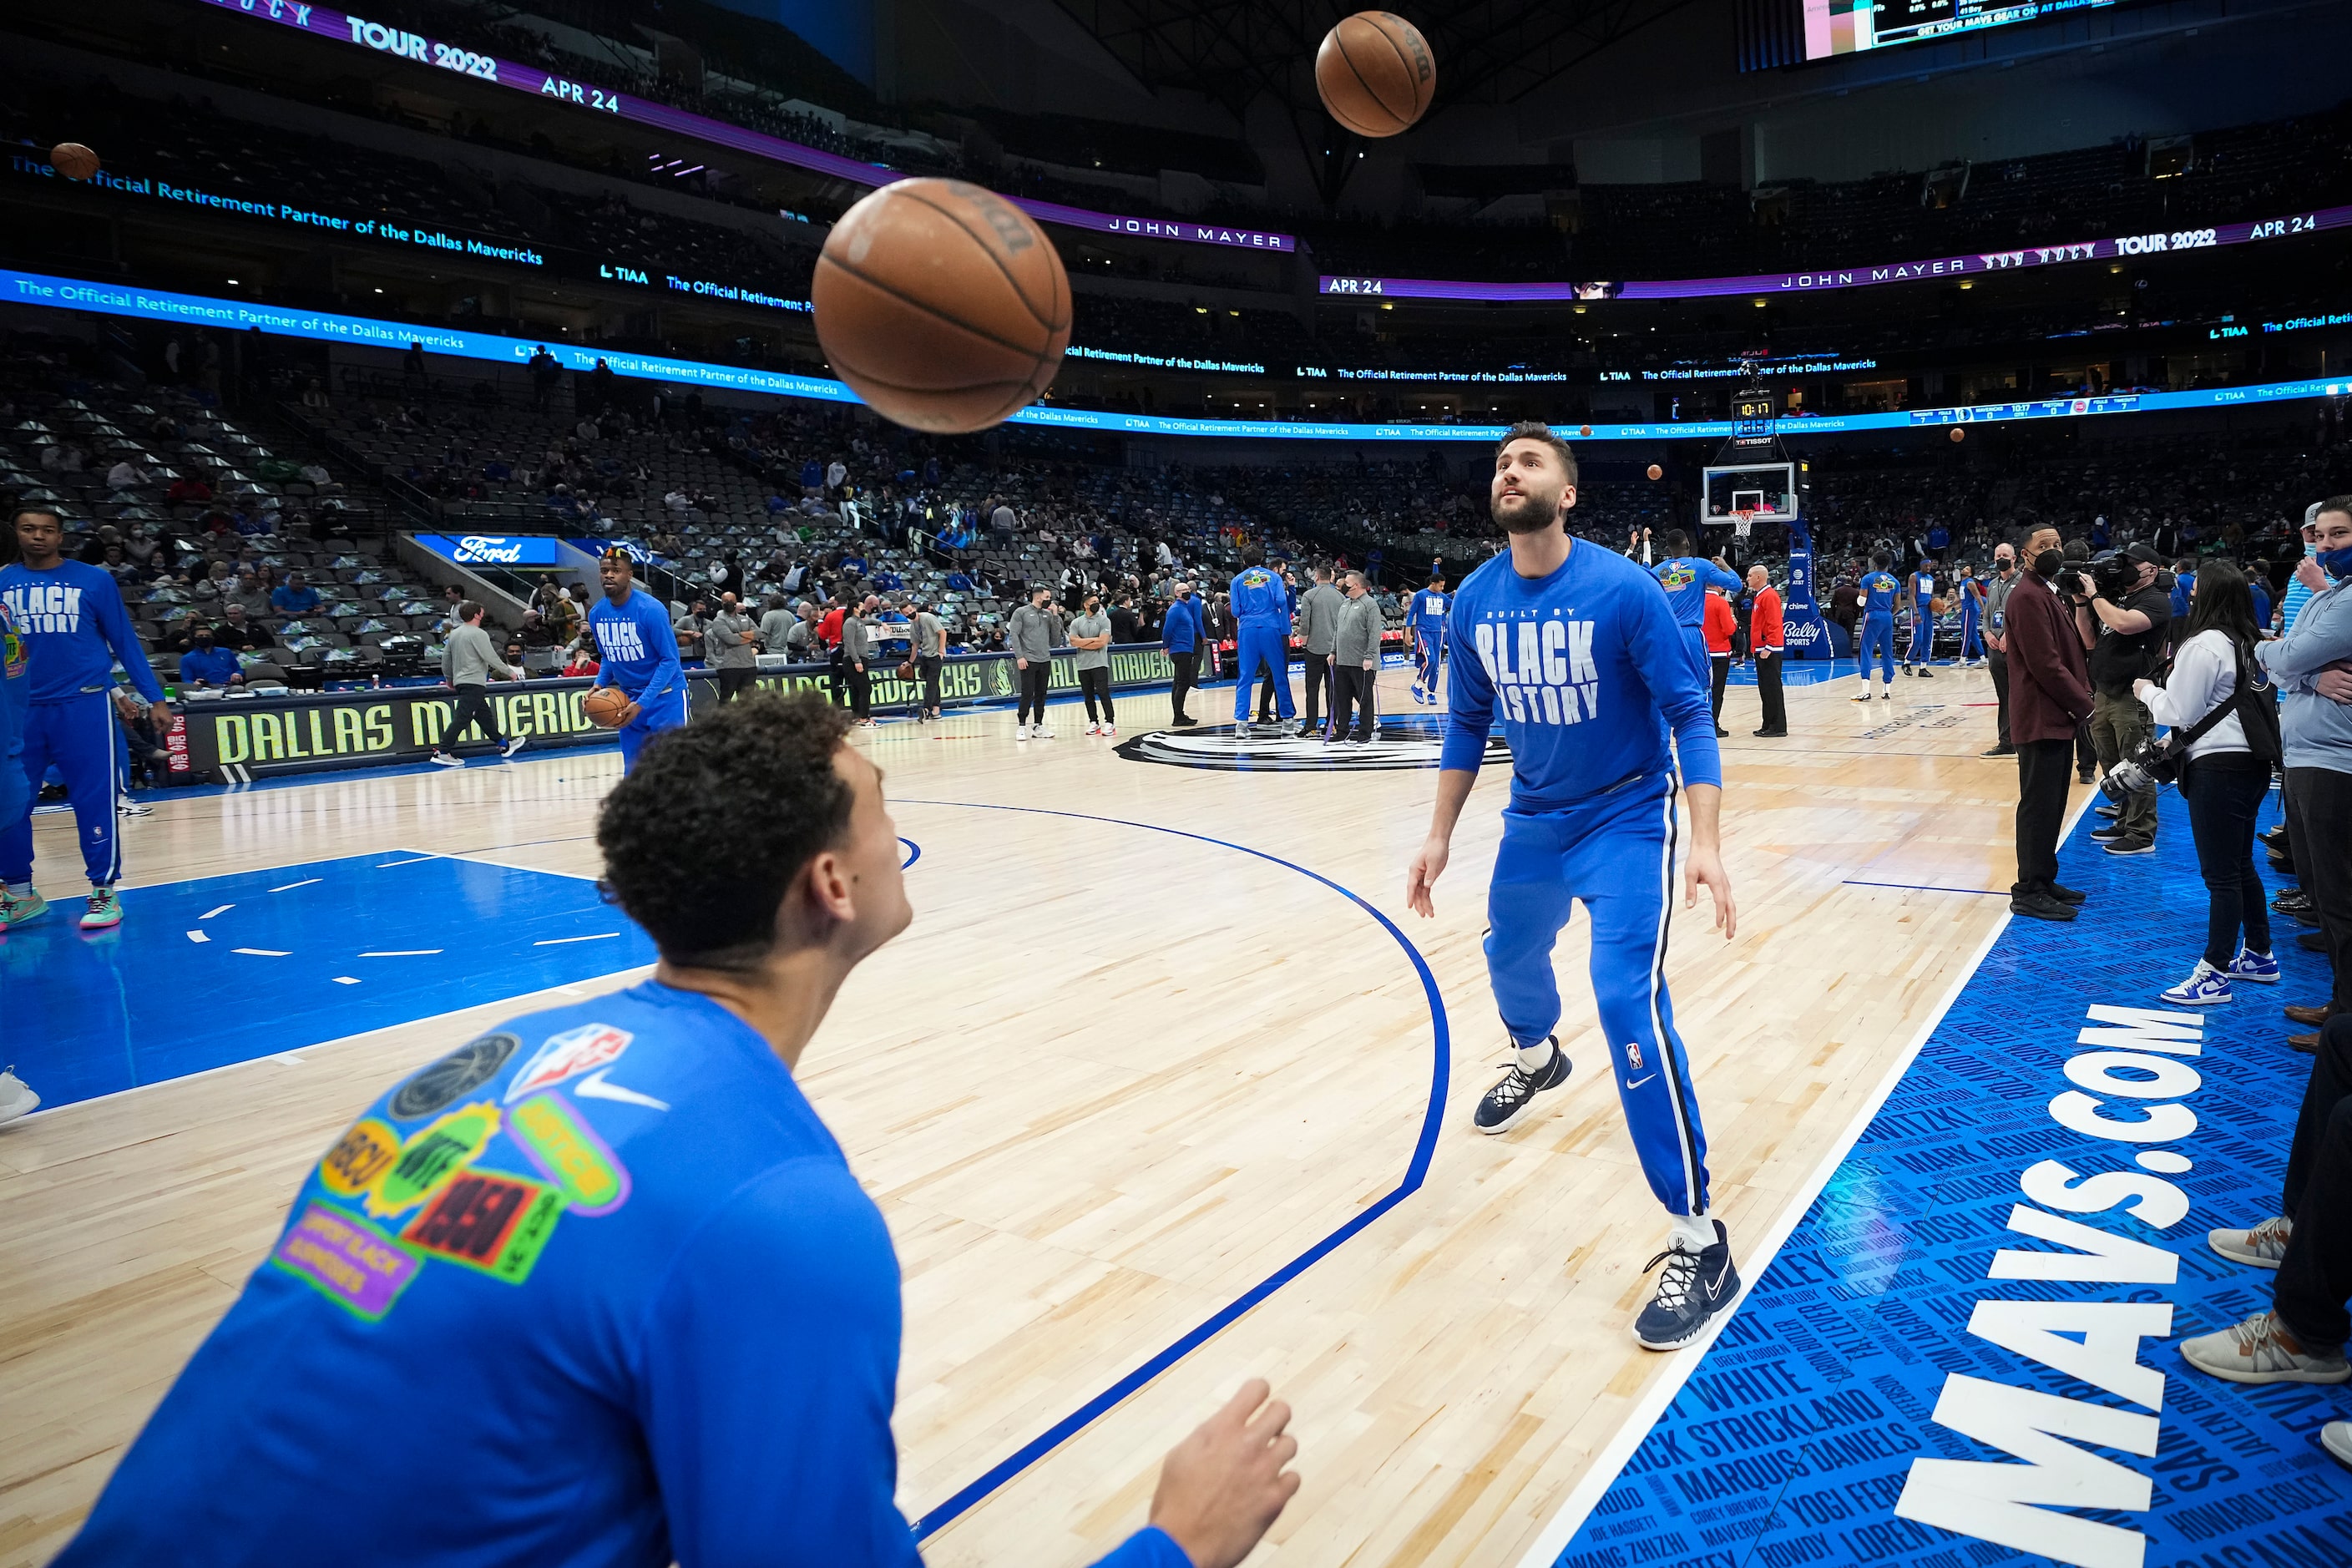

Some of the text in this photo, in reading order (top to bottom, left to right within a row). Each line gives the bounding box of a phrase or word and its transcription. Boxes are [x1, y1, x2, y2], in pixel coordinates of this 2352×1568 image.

[1918, 3, 2054, 37] GET YOUR MAVS GEAR ON AT
[346, 15, 620, 114] TOUR 2022 APR 24
[158, 181, 544, 266] Retirement Partner of the Dallas Mavericks
[1109, 219, 1281, 248] JOHN MAYER
[1781, 215, 2315, 288] JOHN MAYER SOB ROCK TOUR 2022 APR 24
[615, 267, 649, 285] TIAA
[666, 276, 690, 292] The
[693, 281, 738, 300] Official
[741, 290, 803, 312] Retirement
[1329, 278, 1383, 294] APR 24
[15, 280, 464, 349] The Official Retirement Partner of the Dallas Mavericks
[2221, 326, 2248, 336] TIAA
[2263, 321, 2283, 333] The
[2285, 315, 2325, 330] Official
[574, 352, 838, 396] The Retirement Partner of the Dallas Mavericks
[1084, 346, 1265, 374] Retirement Partner of the Dallas Mavericks
[1338, 368, 1567, 382] The Official Retirement Partner the Dallas Mavericks
[1641, 368, 1692, 381] The Official
[1788, 359, 1876, 373] the Dallas Mavericks
[2275, 384, 2308, 396] Official
[1039, 411, 1099, 424] Dallas Mavericks
[1742, 403, 1768, 416] 10:17
[2011, 404, 2031, 412] 10:17
[1172, 421, 1349, 435] Official Retirement Partner Dallas Mavericks
[1425, 427, 1450, 437] Official
[1670, 426, 1696, 435] Official
[1810, 419, 1844, 429] Mavericks
[453, 535, 522, 564] Ford
[3, 586, 83, 615] BLACK
[1487, 608, 1575, 619] BUILT BY
[596, 621, 642, 650] BLACK
[1783, 620, 1821, 643] Bally
[1786, 638, 1810, 646] SPORTS
[1383, 654, 1404, 663] GEICO
[1475, 620, 1599, 686] BLACK
[215, 705, 394, 764] DALLAS
[1949, 1020, 2022, 1045] TERRY
[1933, 1055, 2047, 1100] ROLANDO
[2193, 1055, 2272, 1086] TYSON
[1889, 1088, 1979, 1112] STEVENSON
[1979, 1103, 2050, 1123] TERRY TYLER
[2183, 1094, 2278, 1126] JAMES
[1975, 1120, 2028, 1135] DOMINIQUE
[518, 1100, 611, 1198] JUSTICE
[1892, 1127, 2096, 1174] MARK AGUIRRE
[1916, 1169, 2024, 1206] EDUARDO
[2184, 1176, 2253, 1196] DUMAS
[1815, 1218, 1892, 1244] JACKSON
[1872, 1232, 1914, 1250] BOOTH
[1902, 1211, 1984, 1247] JOSH
[1756, 1288, 1821, 1310] TOM SLUBY
[1827, 1267, 1936, 1302] OLLIE MACK
[1894, 1002, 2205, 1568] MAVS.COM
[1904, 1283, 1955, 1300] JALEN JONES
[1923, 1280, 2075, 1324] HARRISON
[1798, 1302, 1883, 1362] FAT LEVER
[1867, 1296, 1980, 1376] TOM LAGARDE
[1712, 1343, 1791, 1368] DREW GOODEN
[1773, 1319, 1855, 1383] CARON BUTLER
[1686, 1359, 1812, 1413] WHITE
[1871, 1374, 1932, 1423] JEFFERSON
[1687, 1388, 1884, 1458] STRICKLAND
[2192, 1412, 2280, 1459] JALEN
[1672, 1422, 1922, 1505] MARQUIS DANIELS
[2152, 1424, 2240, 1493] SAM
[1690, 1495, 1772, 1525] COREY BREWER
[1782, 1488, 1856, 1528] YOGI
[2164, 1473, 2345, 1544] HOWARD EISLEY
[1589, 1515, 1659, 1543] JOE HASSETT
[1699, 1511, 1787, 1549] MAVERICKS
[1756, 1531, 1834, 1568] ROWDY
[1839, 1518, 1935, 1564] LOREN
[1565, 1545, 1628, 1568] WANG
[1624, 1531, 1690, 1565] ZHIZHI
